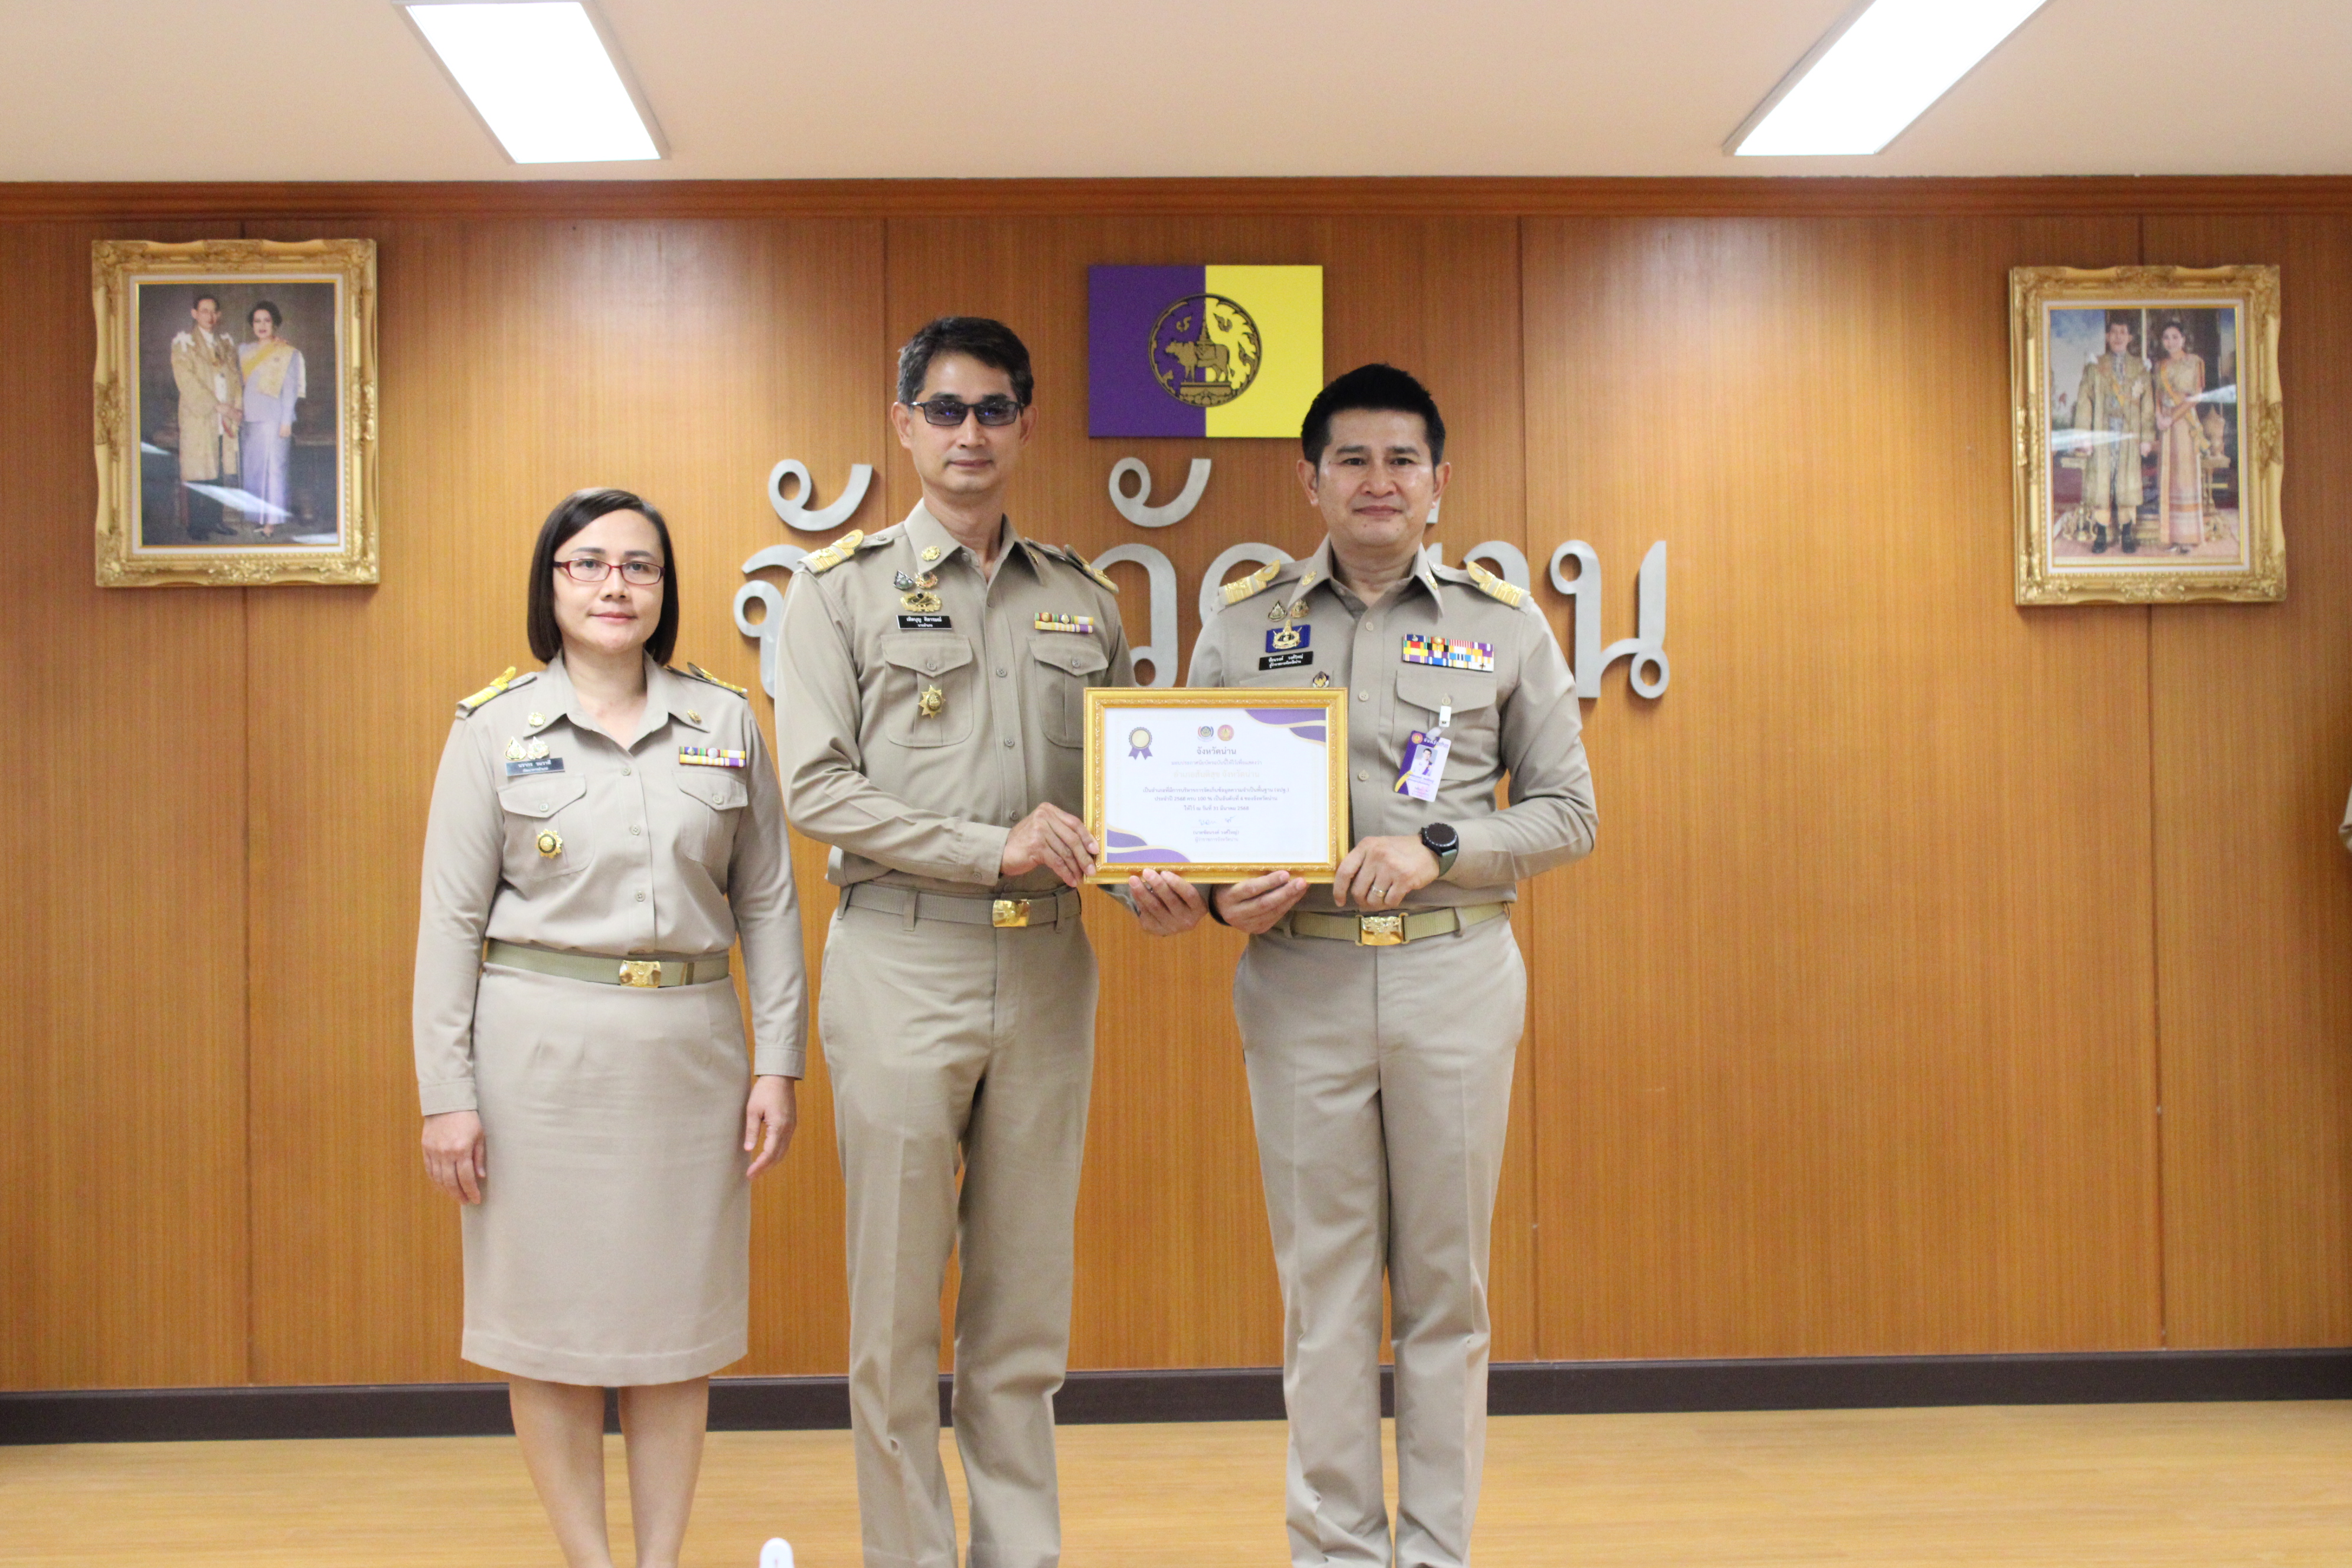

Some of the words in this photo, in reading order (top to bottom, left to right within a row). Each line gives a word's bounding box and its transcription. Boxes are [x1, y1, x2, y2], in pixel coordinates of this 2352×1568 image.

[1197, 746, 1237, 755] จังหวัดน่าน
[1222, 769, 1260, 778] จังหวัดน่าน
